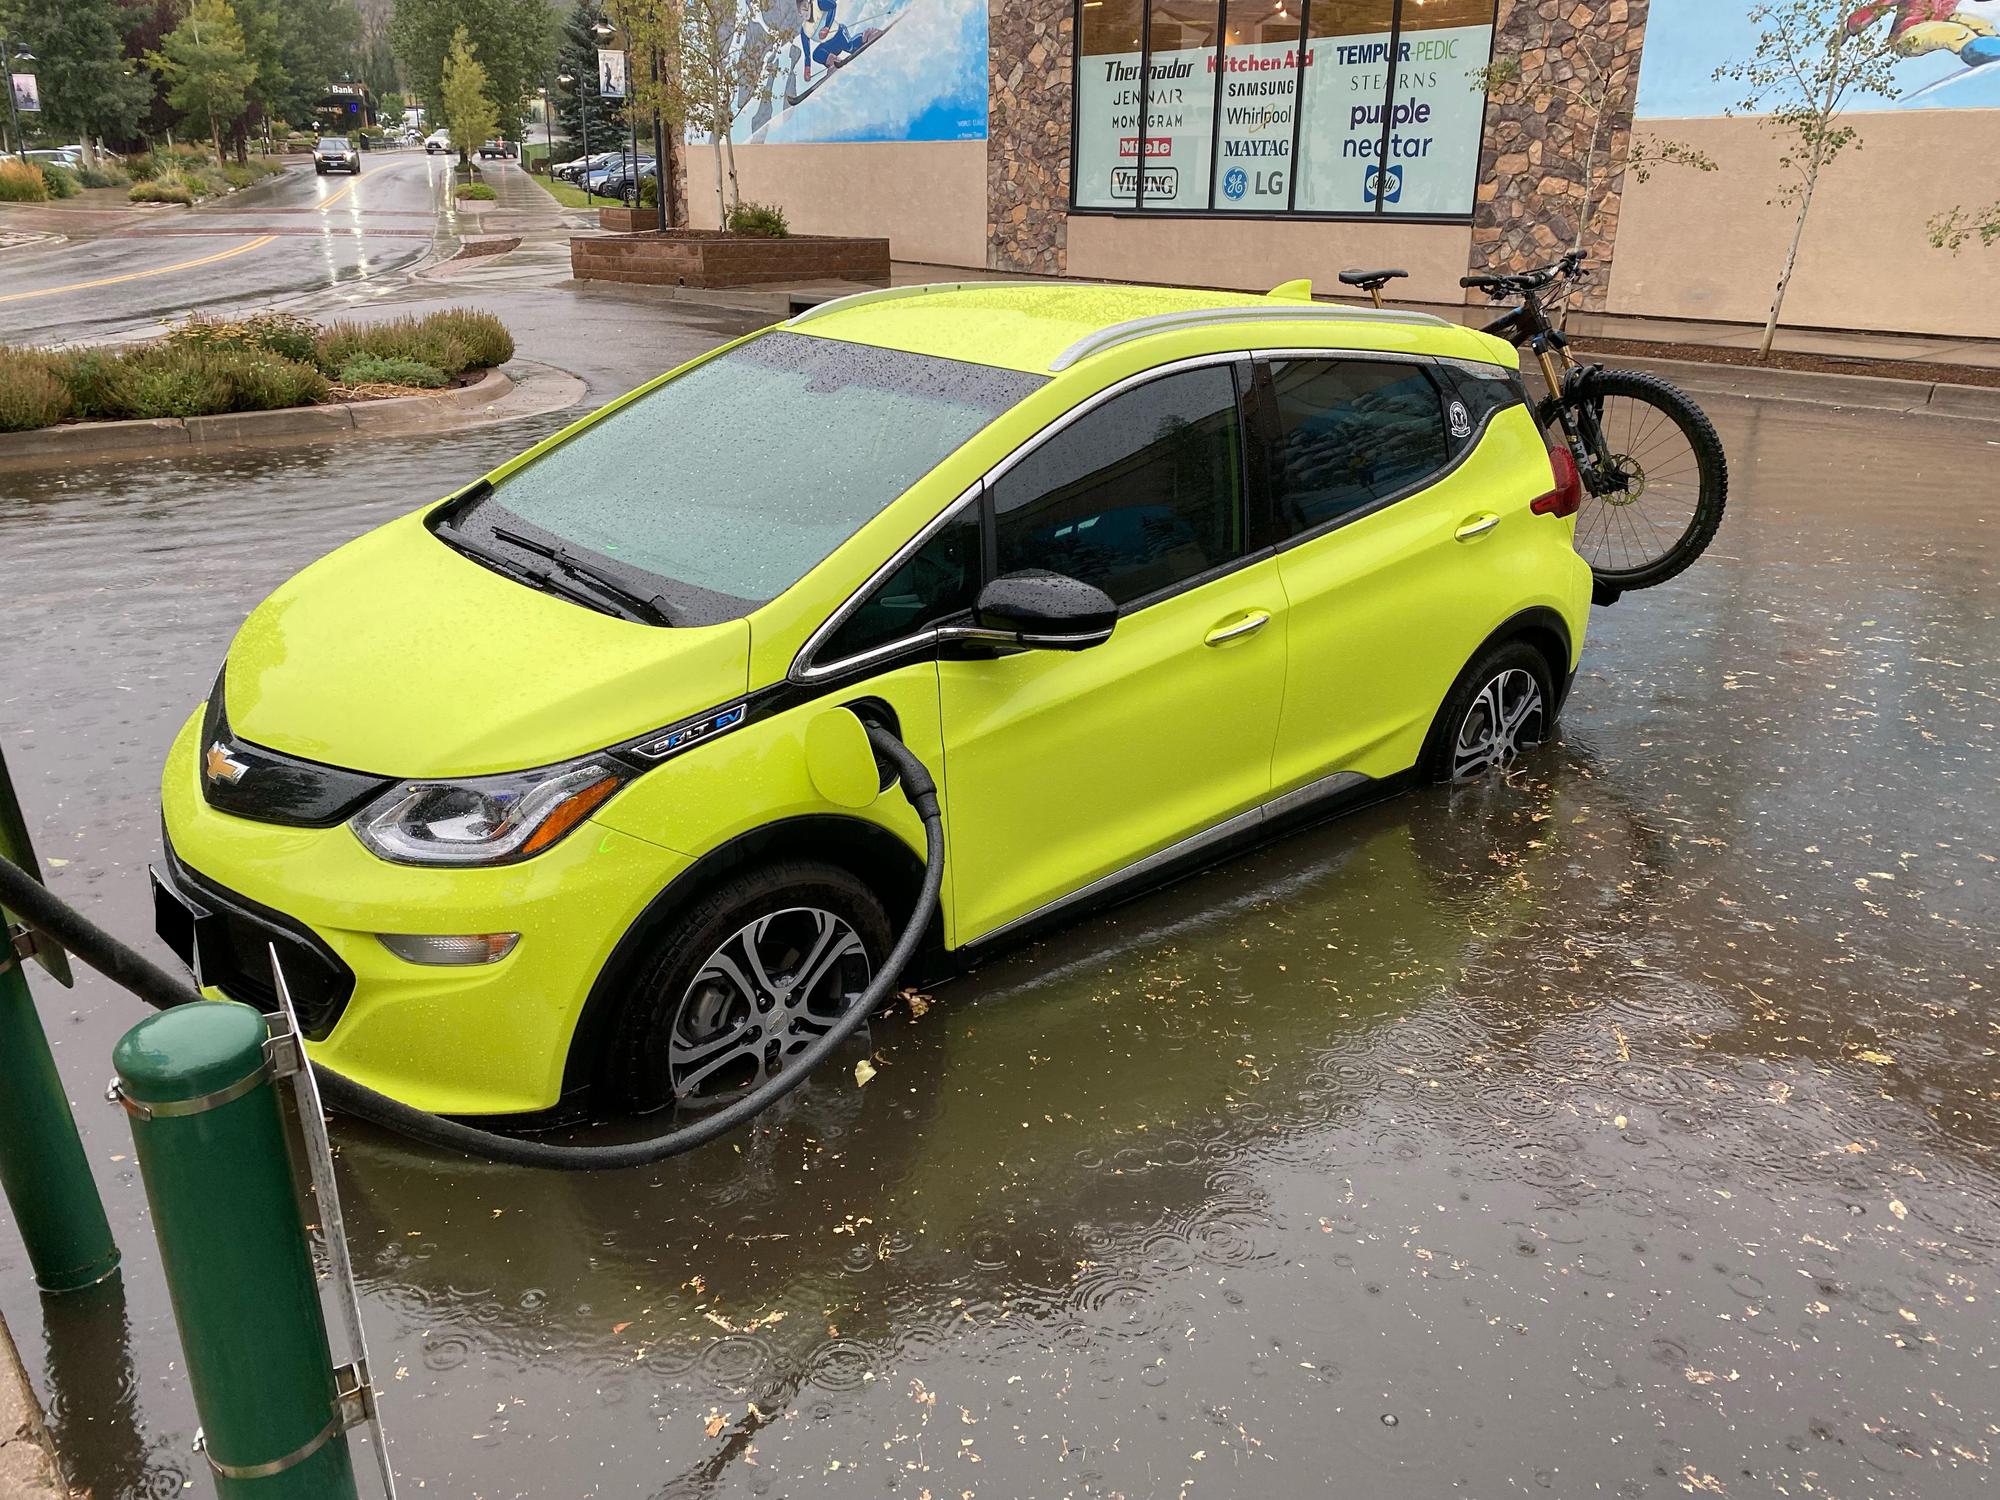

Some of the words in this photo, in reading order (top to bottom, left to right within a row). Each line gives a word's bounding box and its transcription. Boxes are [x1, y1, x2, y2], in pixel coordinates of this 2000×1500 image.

[332, 85, 353, 94] Bank
[1228, 80, 1295, 97] SAMSUNG
[1351, 72, 1437, 91] STERNS
[1227, 105, 1292, 129] Whirlpool
[1224, 139, 1289, 157] MAYTAG
[1343, 134, 1433, 158] nectar
[1255, 171, 1284, 195] LG
[1369, 175, 1396, 192] Sely
[715, 710, 740, 729] EV
